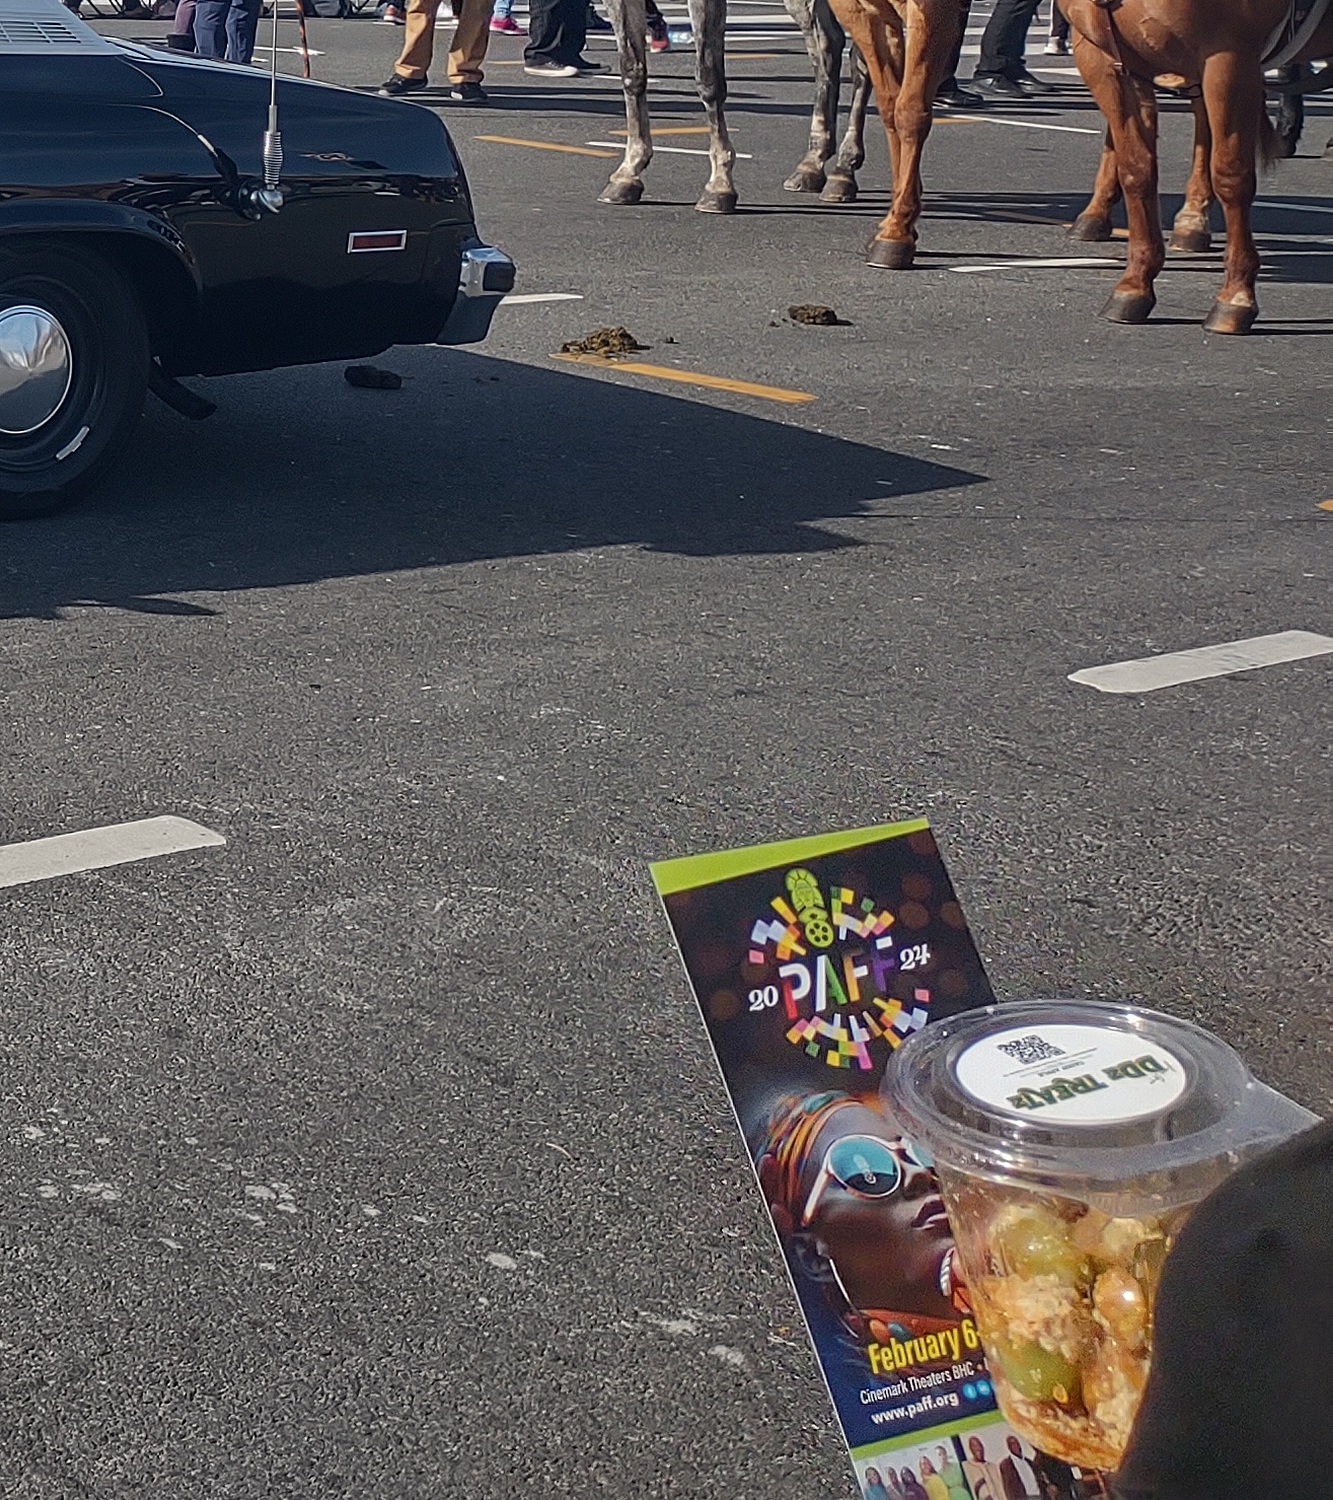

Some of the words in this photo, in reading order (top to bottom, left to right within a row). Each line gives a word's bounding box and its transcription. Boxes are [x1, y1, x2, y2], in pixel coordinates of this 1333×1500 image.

[748, 985, 779, 1012] 20
[778, 935, 896, 1020] PAFF
[900, 943, 931, 971] 24
[867, 1327, 960, 1374] February
[859, 1378, 909, 1405] Cinemark
[908, 1368, 952, 1392] Theaters
[951, 1360, 976, 1381] BHC
[871, 1391, 960, 1426] www.paff.org
